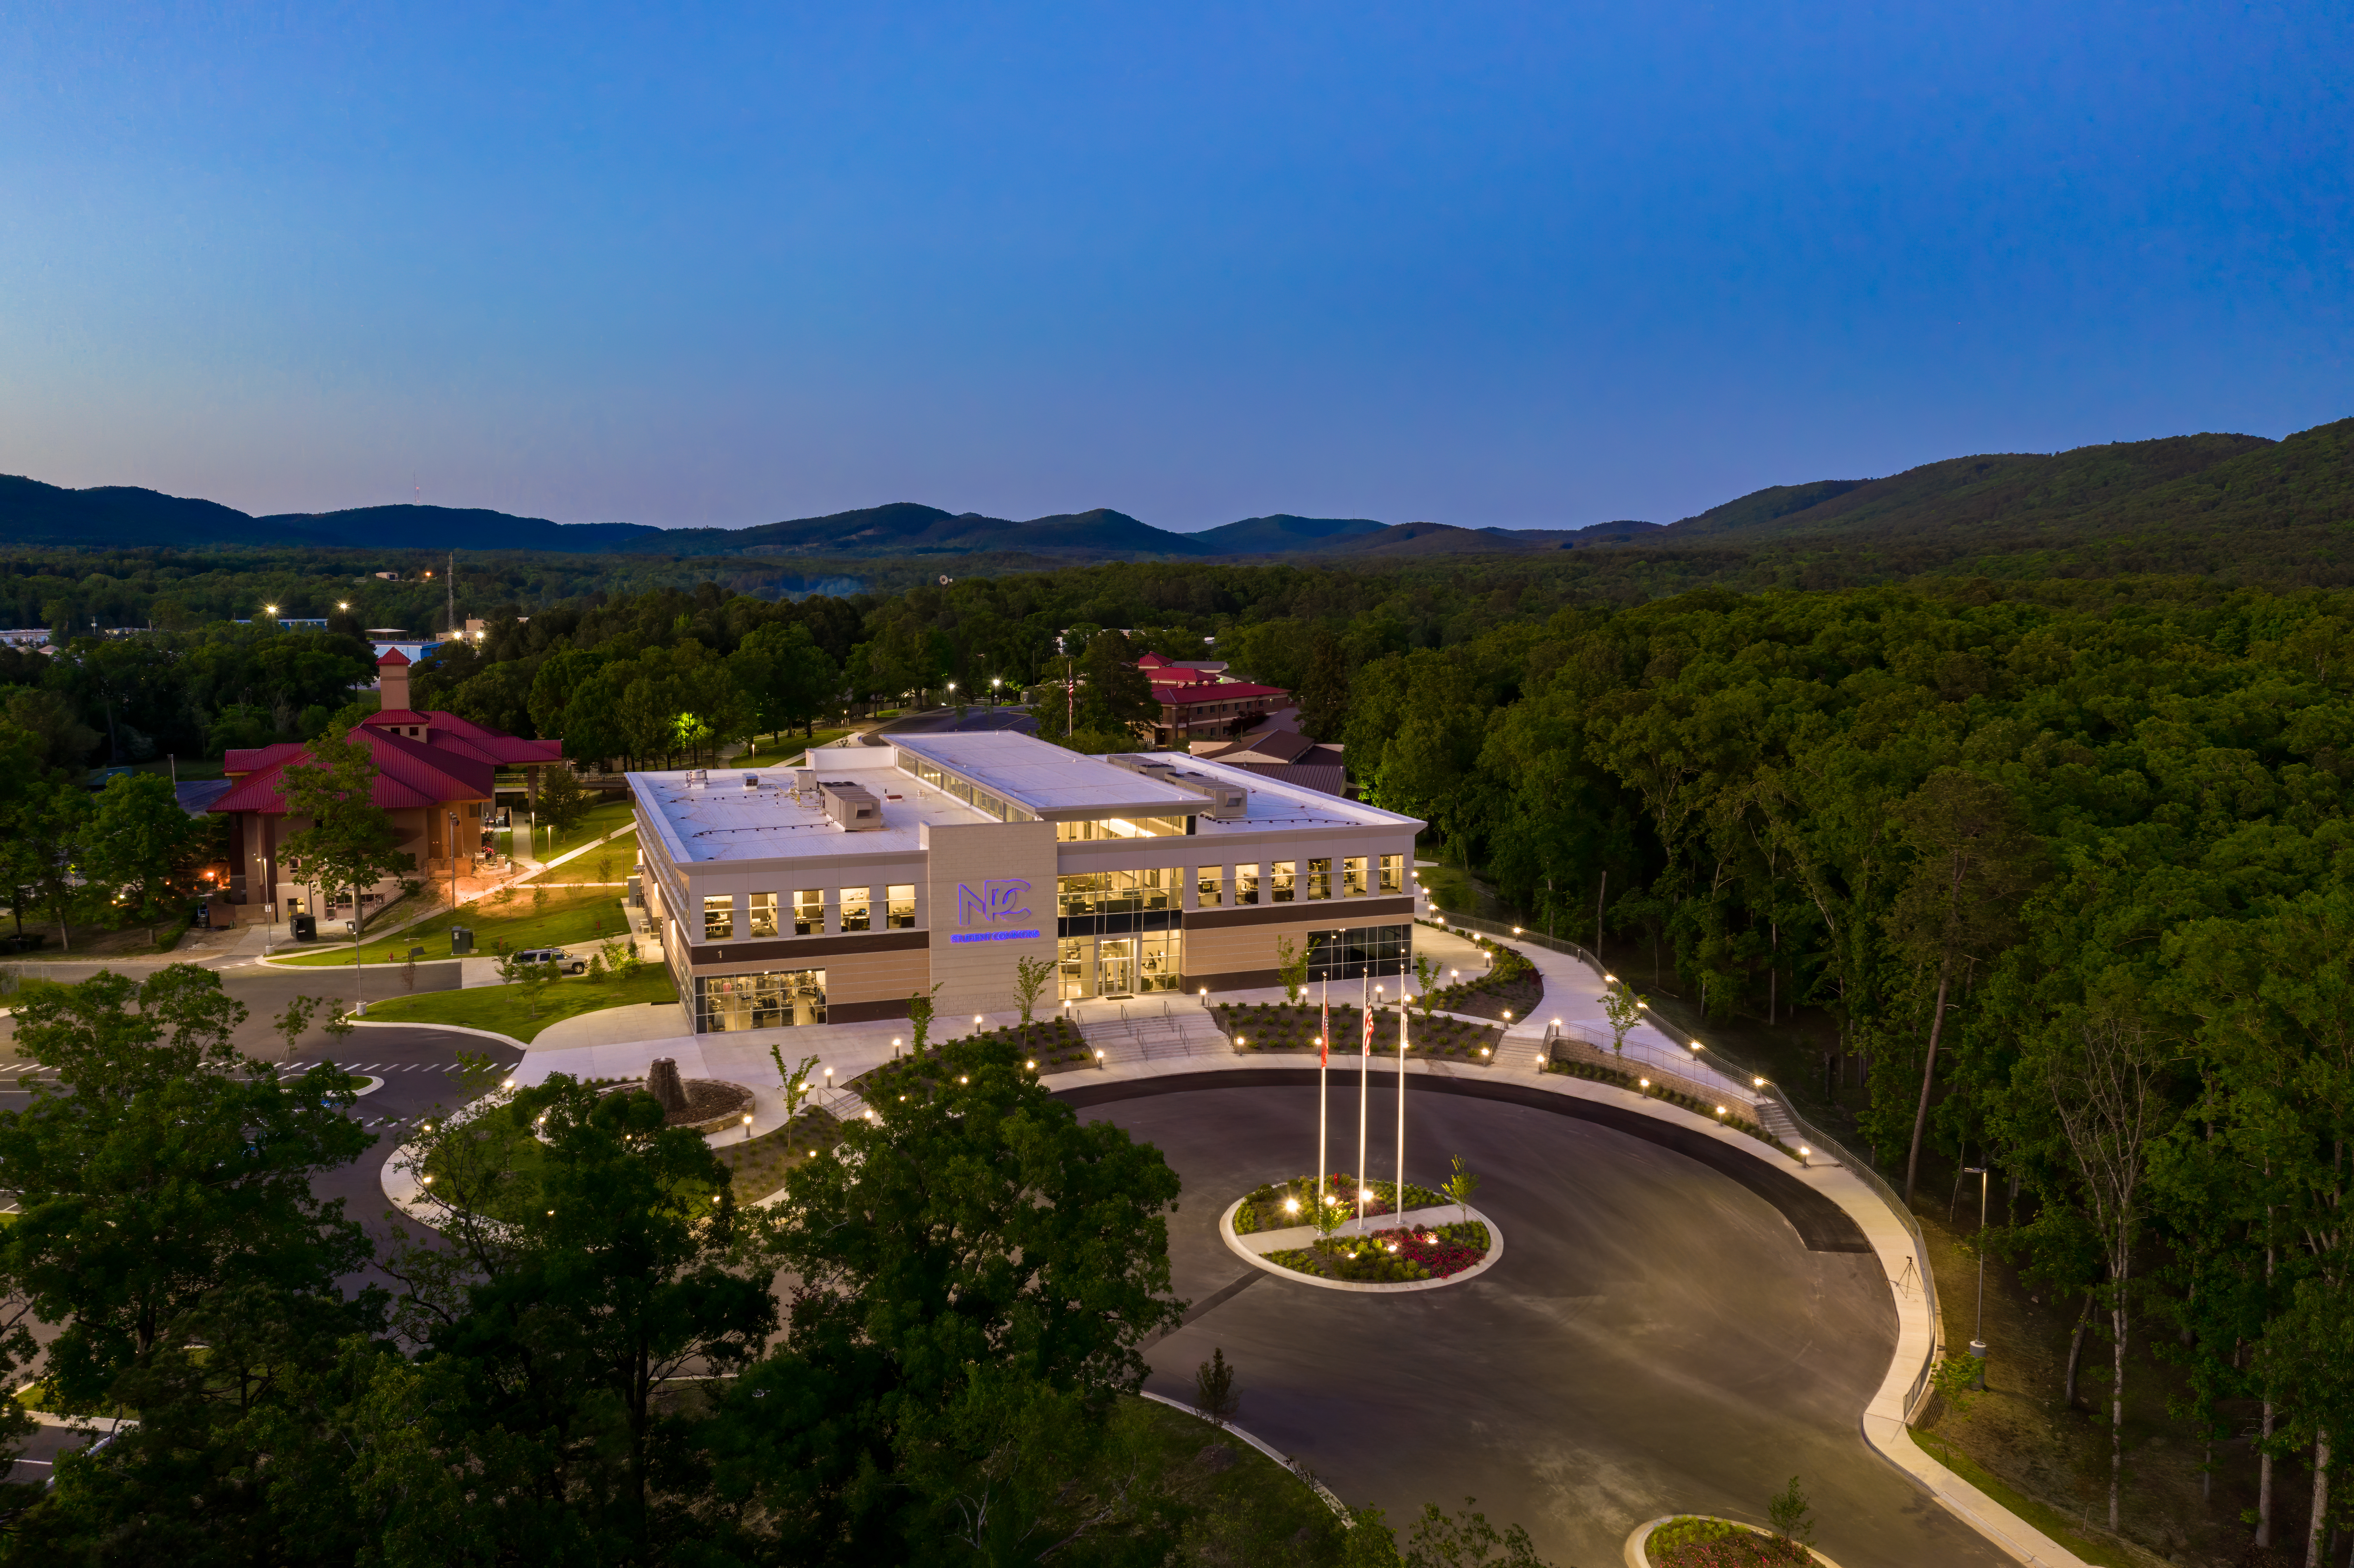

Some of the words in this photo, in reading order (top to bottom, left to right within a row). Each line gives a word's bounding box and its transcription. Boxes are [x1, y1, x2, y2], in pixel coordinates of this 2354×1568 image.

[959, 879, 1031, 925] NPC
[950, 933, 991, 943] STUDENT
[991, 930, 1040, 941] COMMONS
